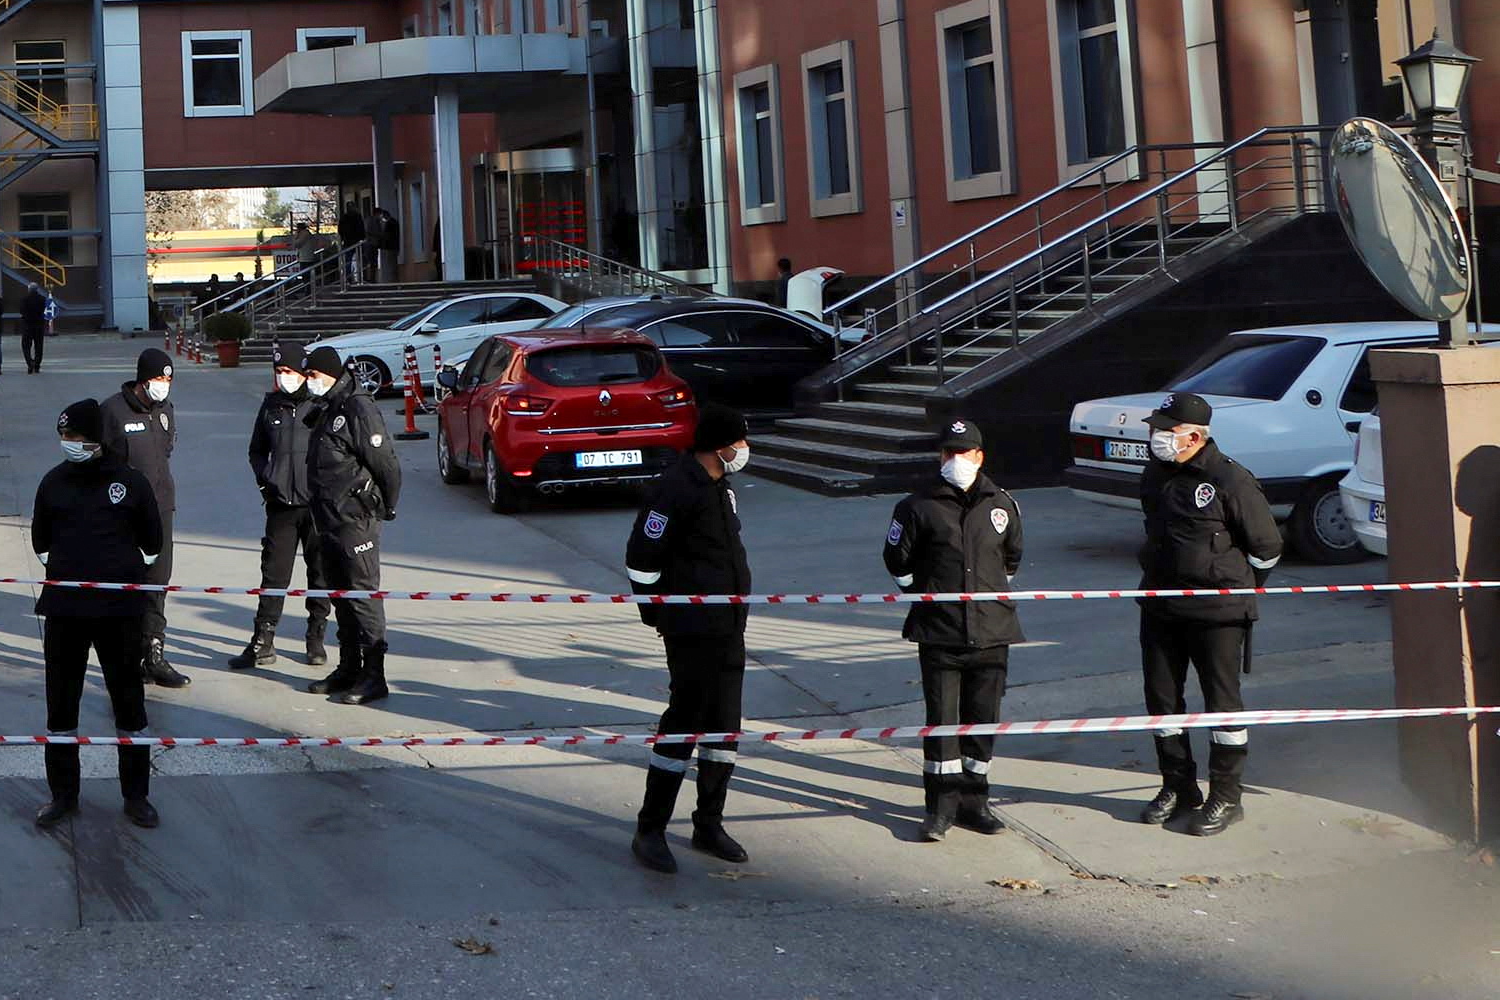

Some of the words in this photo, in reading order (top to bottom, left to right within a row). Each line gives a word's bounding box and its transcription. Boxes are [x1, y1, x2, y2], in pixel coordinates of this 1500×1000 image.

[276, 254, 298, 264] OTOP
[1110, 443, 1119, 456] 27
[583, 454, 596, 465] 07
[603, 453, 614, 464] TC
[621, 452, 639, 463] 791
[1373, 503, 1386, 520] 34
